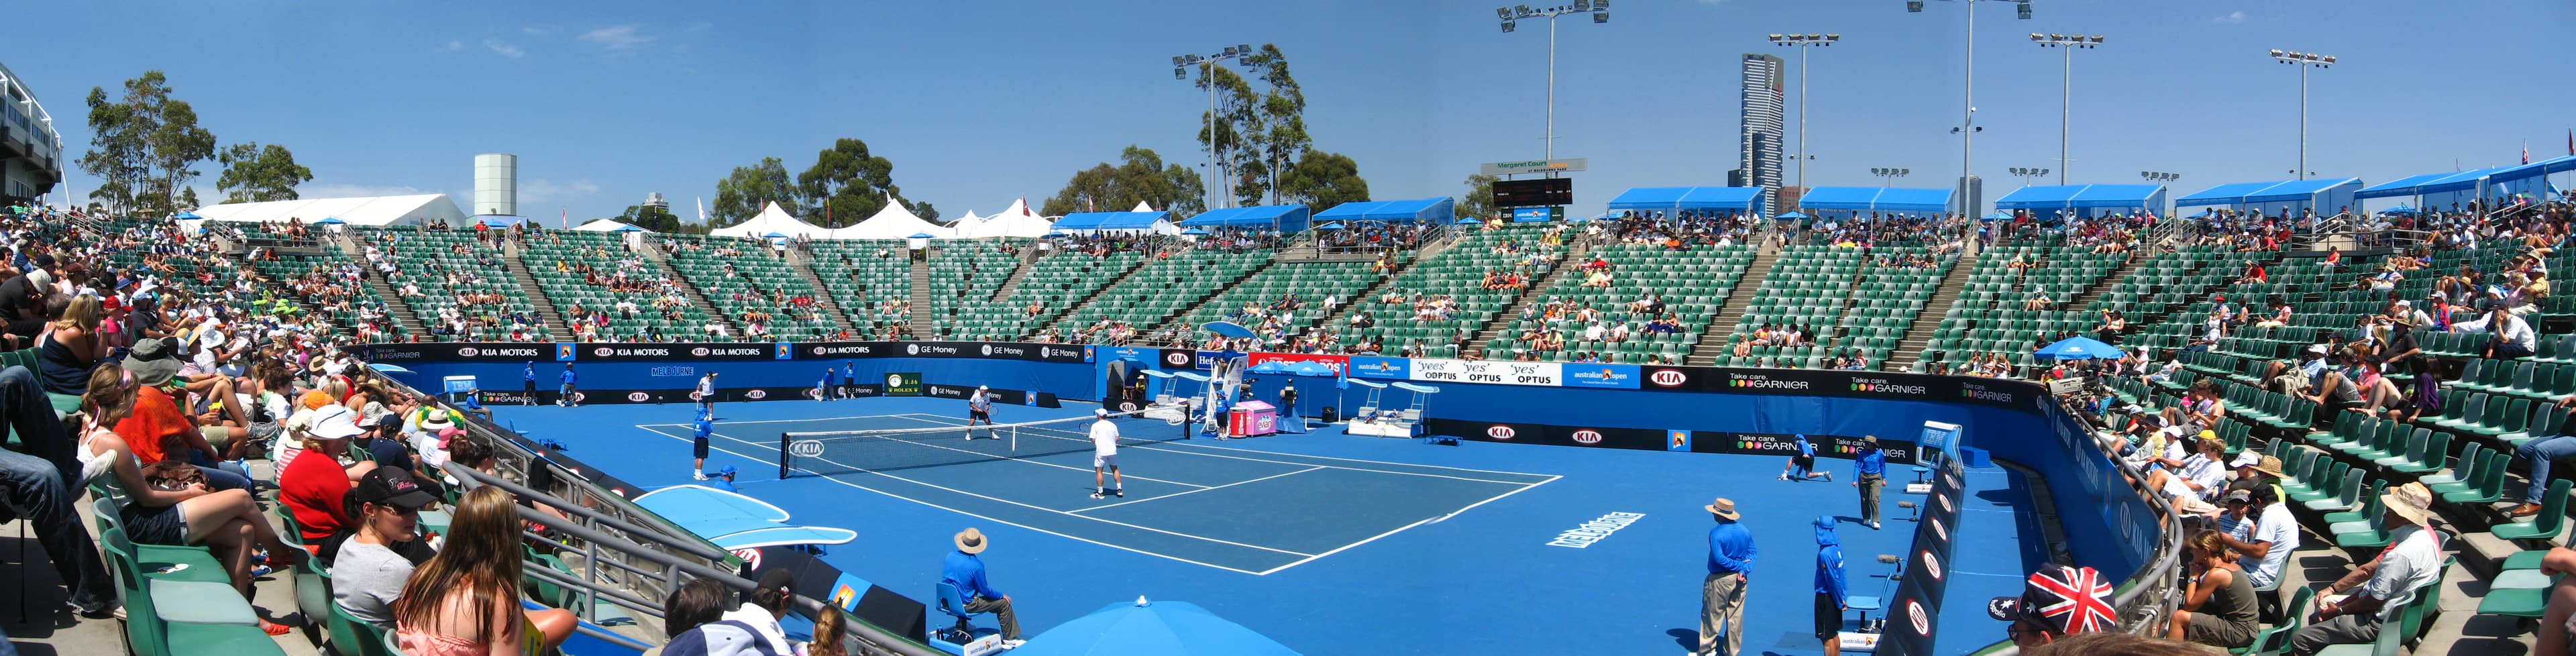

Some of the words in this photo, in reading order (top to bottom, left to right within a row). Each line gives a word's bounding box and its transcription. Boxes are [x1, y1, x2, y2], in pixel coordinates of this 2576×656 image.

[934, 346, 957, 354] Money
[1004, 347, 1024, 356] Money
[1051, 349, 1059, 357] GE
[1059, 349, 1079, 358] Money
[651, 366, 694, 376] MELBOURNE
[1469, 374, 1501, 382] OPTUS
[1517, 376, 1551, 384] OPTUS
[946, 388, 961, 396] Money
